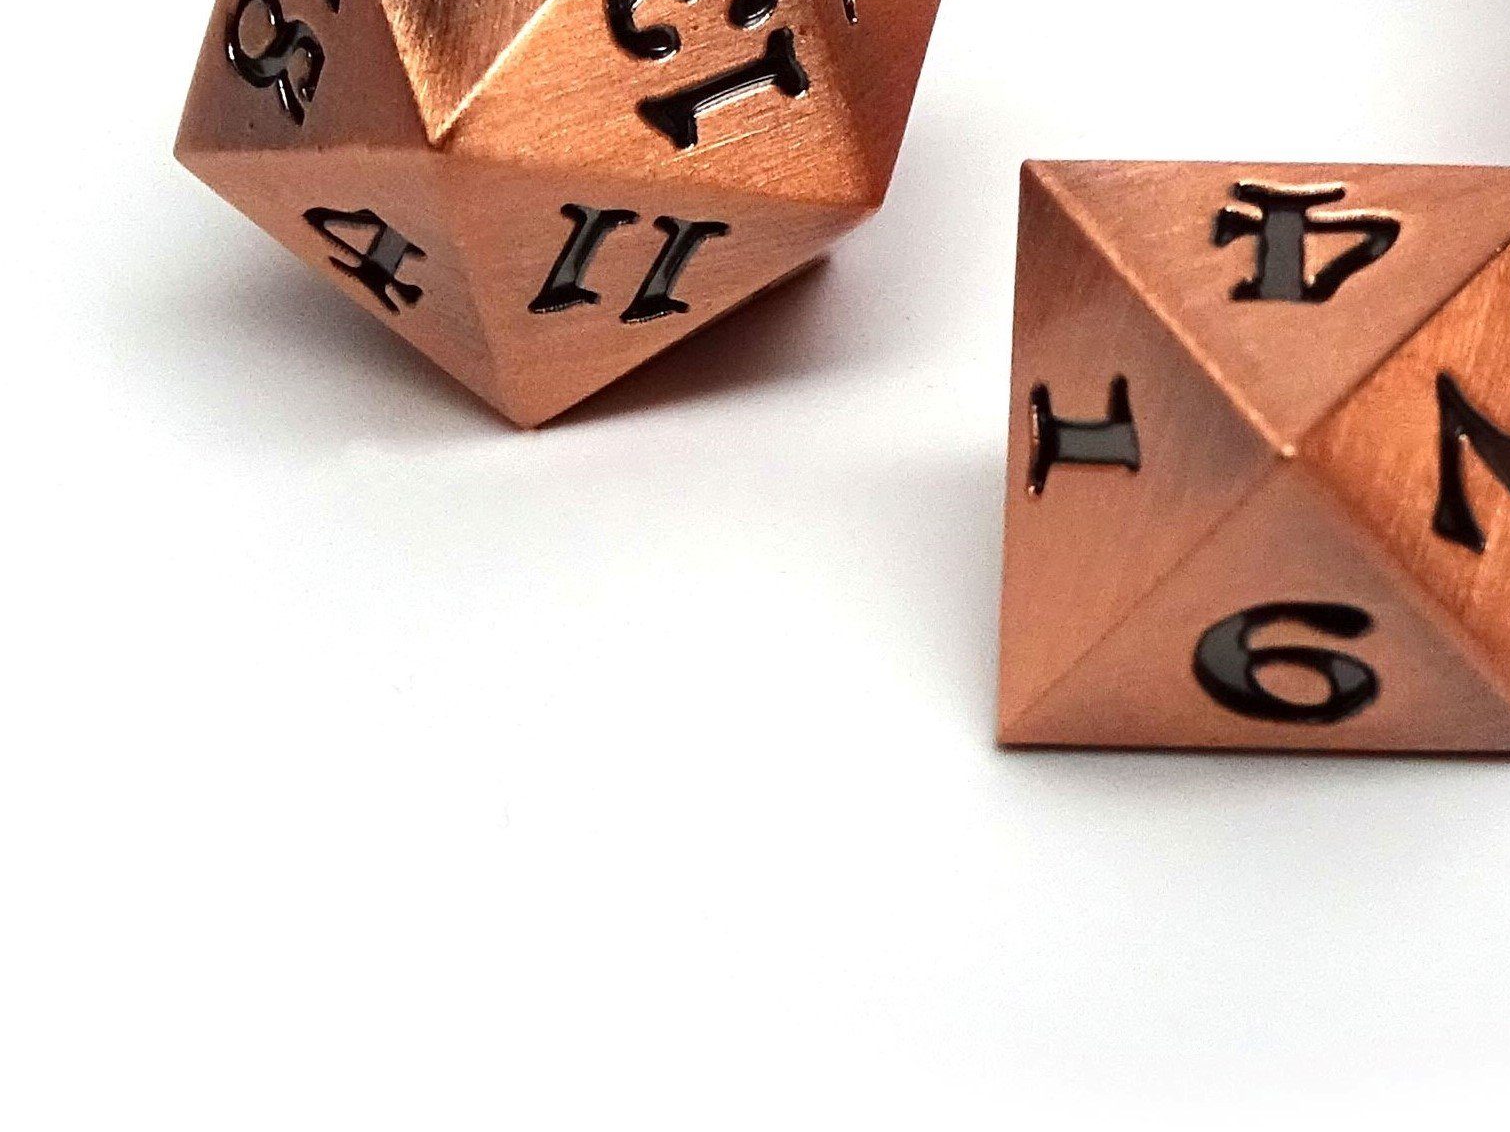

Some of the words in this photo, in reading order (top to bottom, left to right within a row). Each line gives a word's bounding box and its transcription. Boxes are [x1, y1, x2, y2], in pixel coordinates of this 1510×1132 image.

[303, 206, 428, 313] 4
[528, 203, 732, 325] 11
[1212, 181, 1400, 303] 4
[1026, 374, 1141, 497] 1
[1193, 601, 1381, 725] 6
